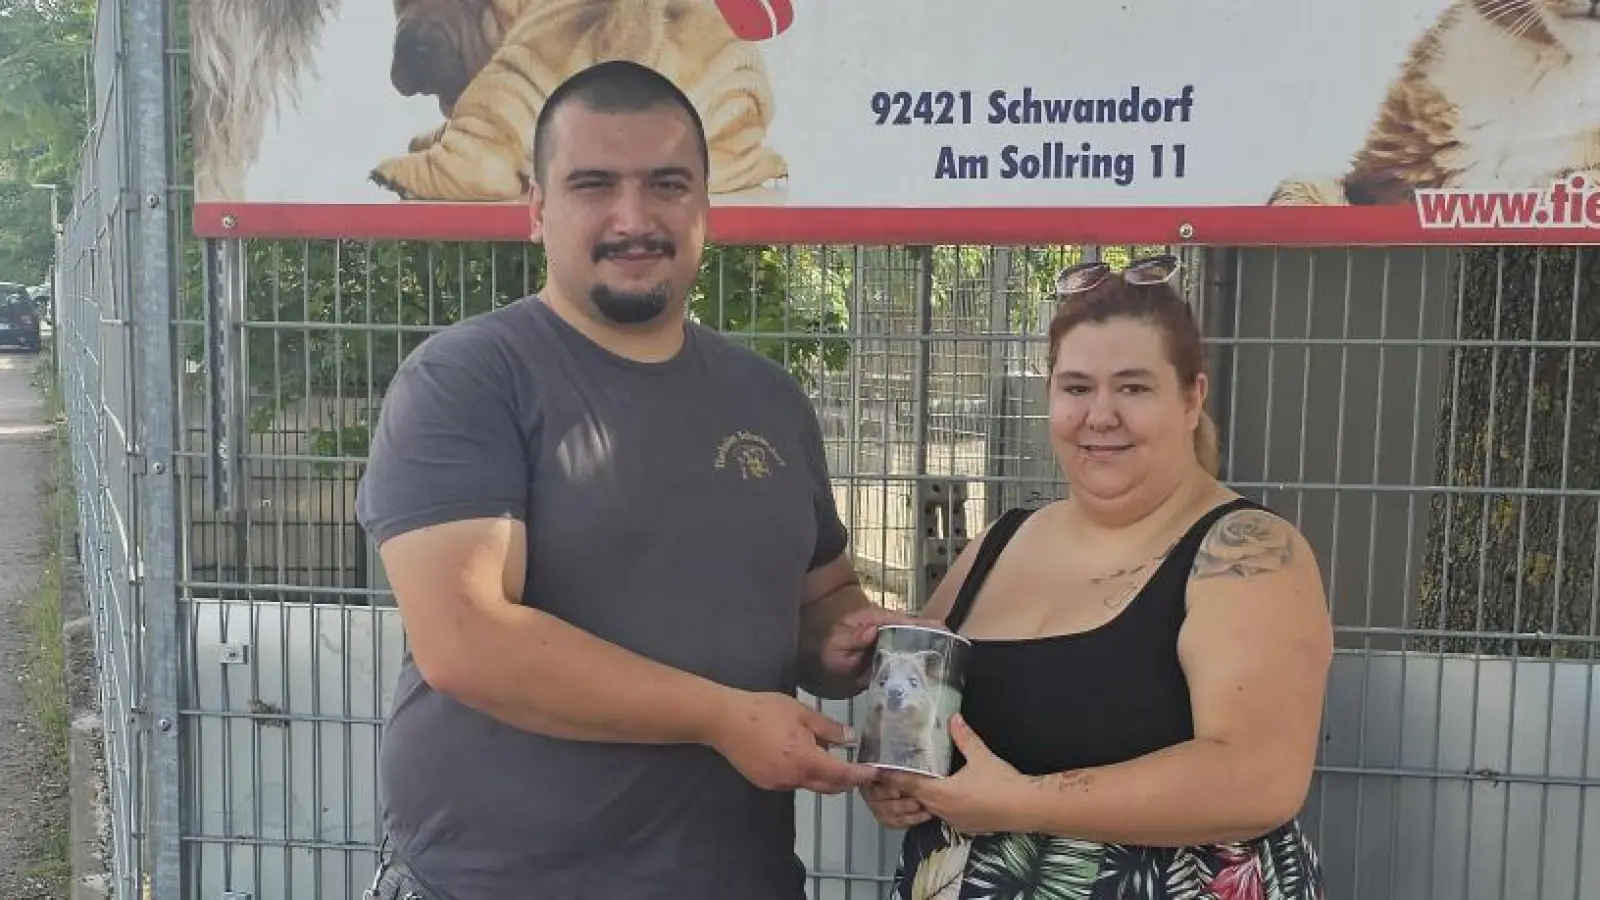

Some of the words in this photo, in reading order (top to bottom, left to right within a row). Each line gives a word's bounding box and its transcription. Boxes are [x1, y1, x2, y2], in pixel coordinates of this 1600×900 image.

[871, 90, 972, 124] 92421
[987, 85, 1194, 124] Schwandorf
[934, 146, 989, 179] Am
[1000, 142, 1134, 186] Sollring
[1150, 144, 1186, 178] 11
